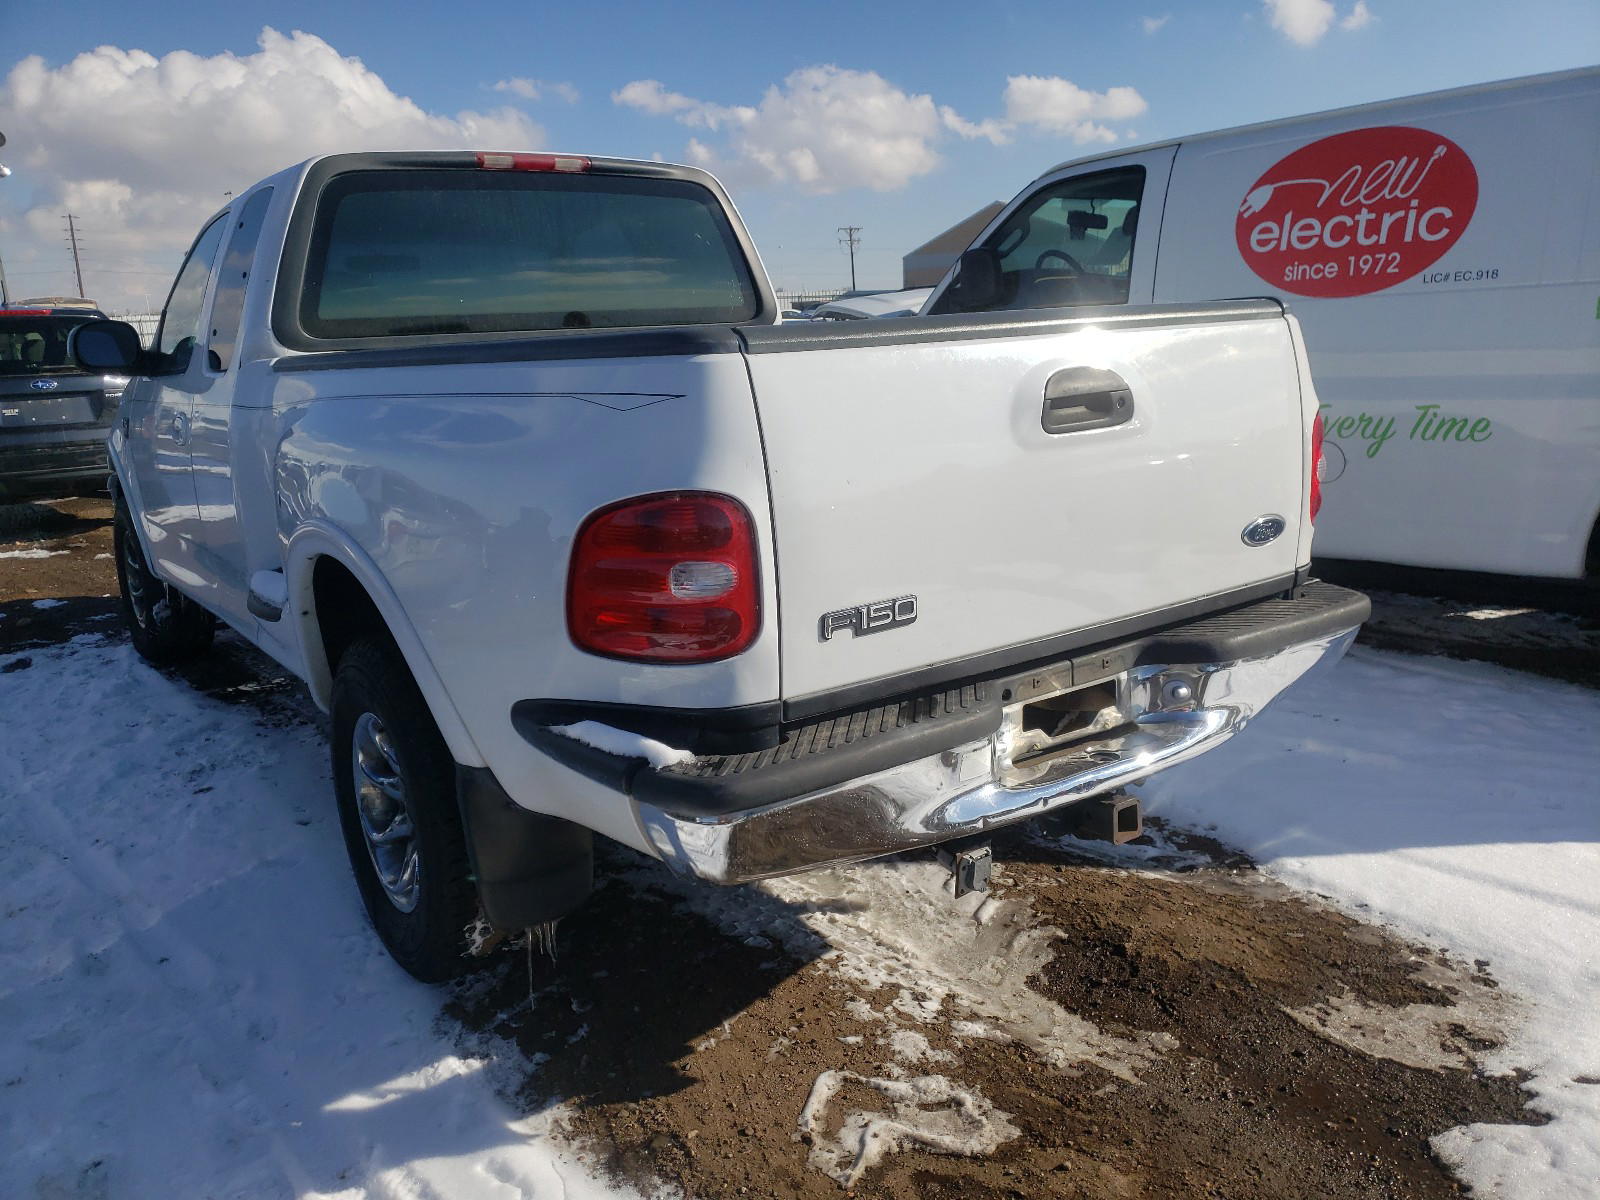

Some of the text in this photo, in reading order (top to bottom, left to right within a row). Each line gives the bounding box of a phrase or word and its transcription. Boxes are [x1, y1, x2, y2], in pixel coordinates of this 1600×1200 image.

[1316, 154, 1436, 208] new
[1250, 199, 1453, 253] electric
[1283, 252, 1401, 282] since 1972
[1422, 272, 1451, 284] LIC#
[1319, 403, 1493, 458] very Time
